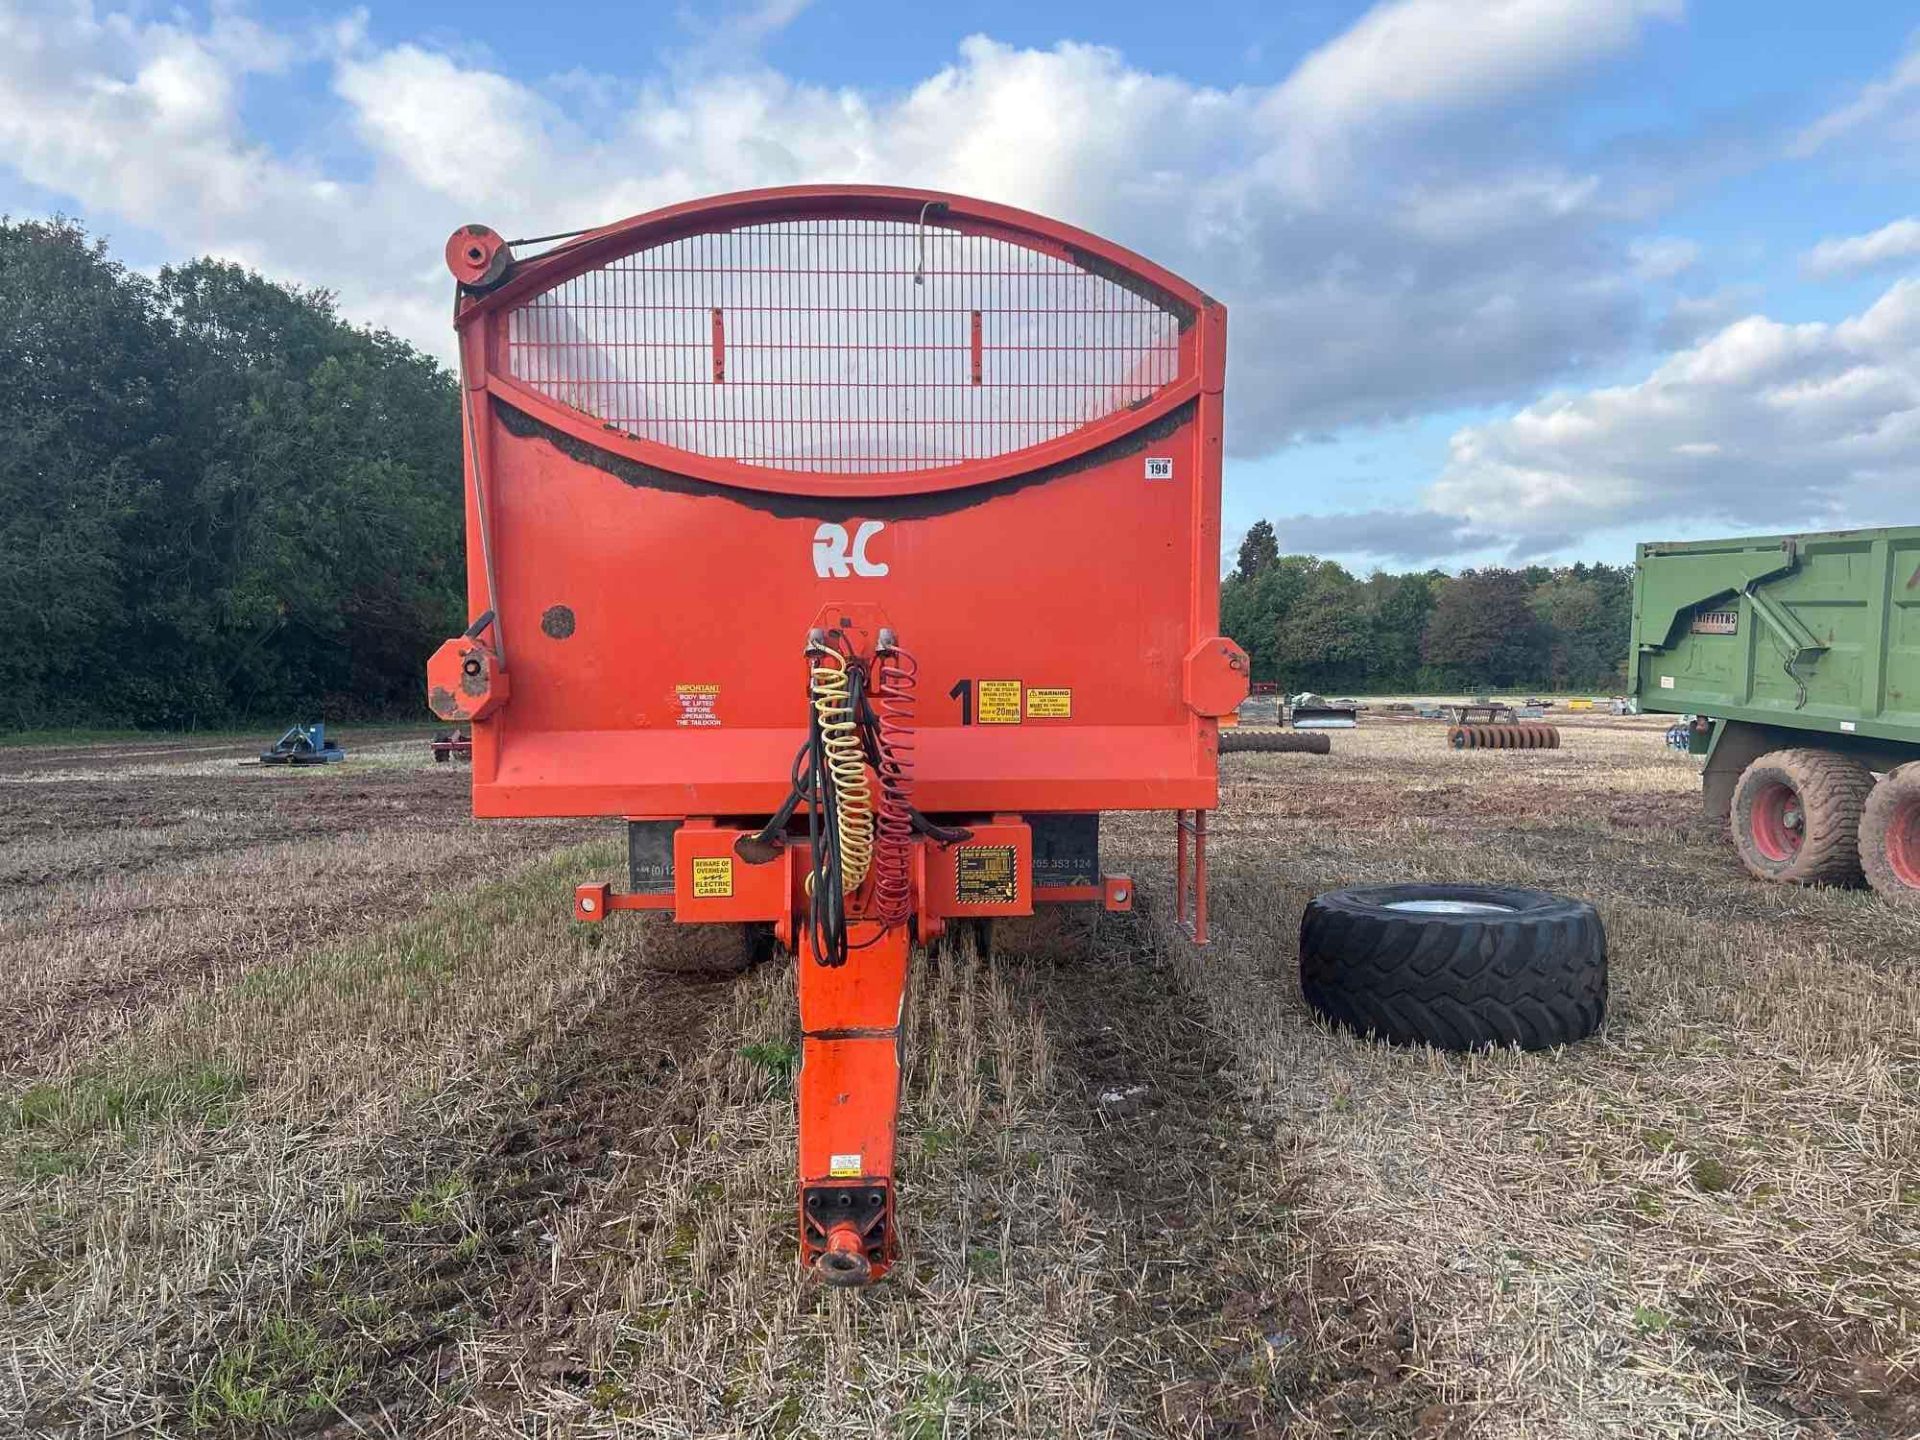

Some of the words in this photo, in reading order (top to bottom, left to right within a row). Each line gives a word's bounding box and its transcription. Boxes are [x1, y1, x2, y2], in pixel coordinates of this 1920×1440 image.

[1150, 463, 1168, 474] 198
[675, 684, 721, 692] IMPORTANT
[949, 679, 972, 726] 1
[996, 707, 1020, 717] 20mph
[1072, 859, 1091, 868] 124
